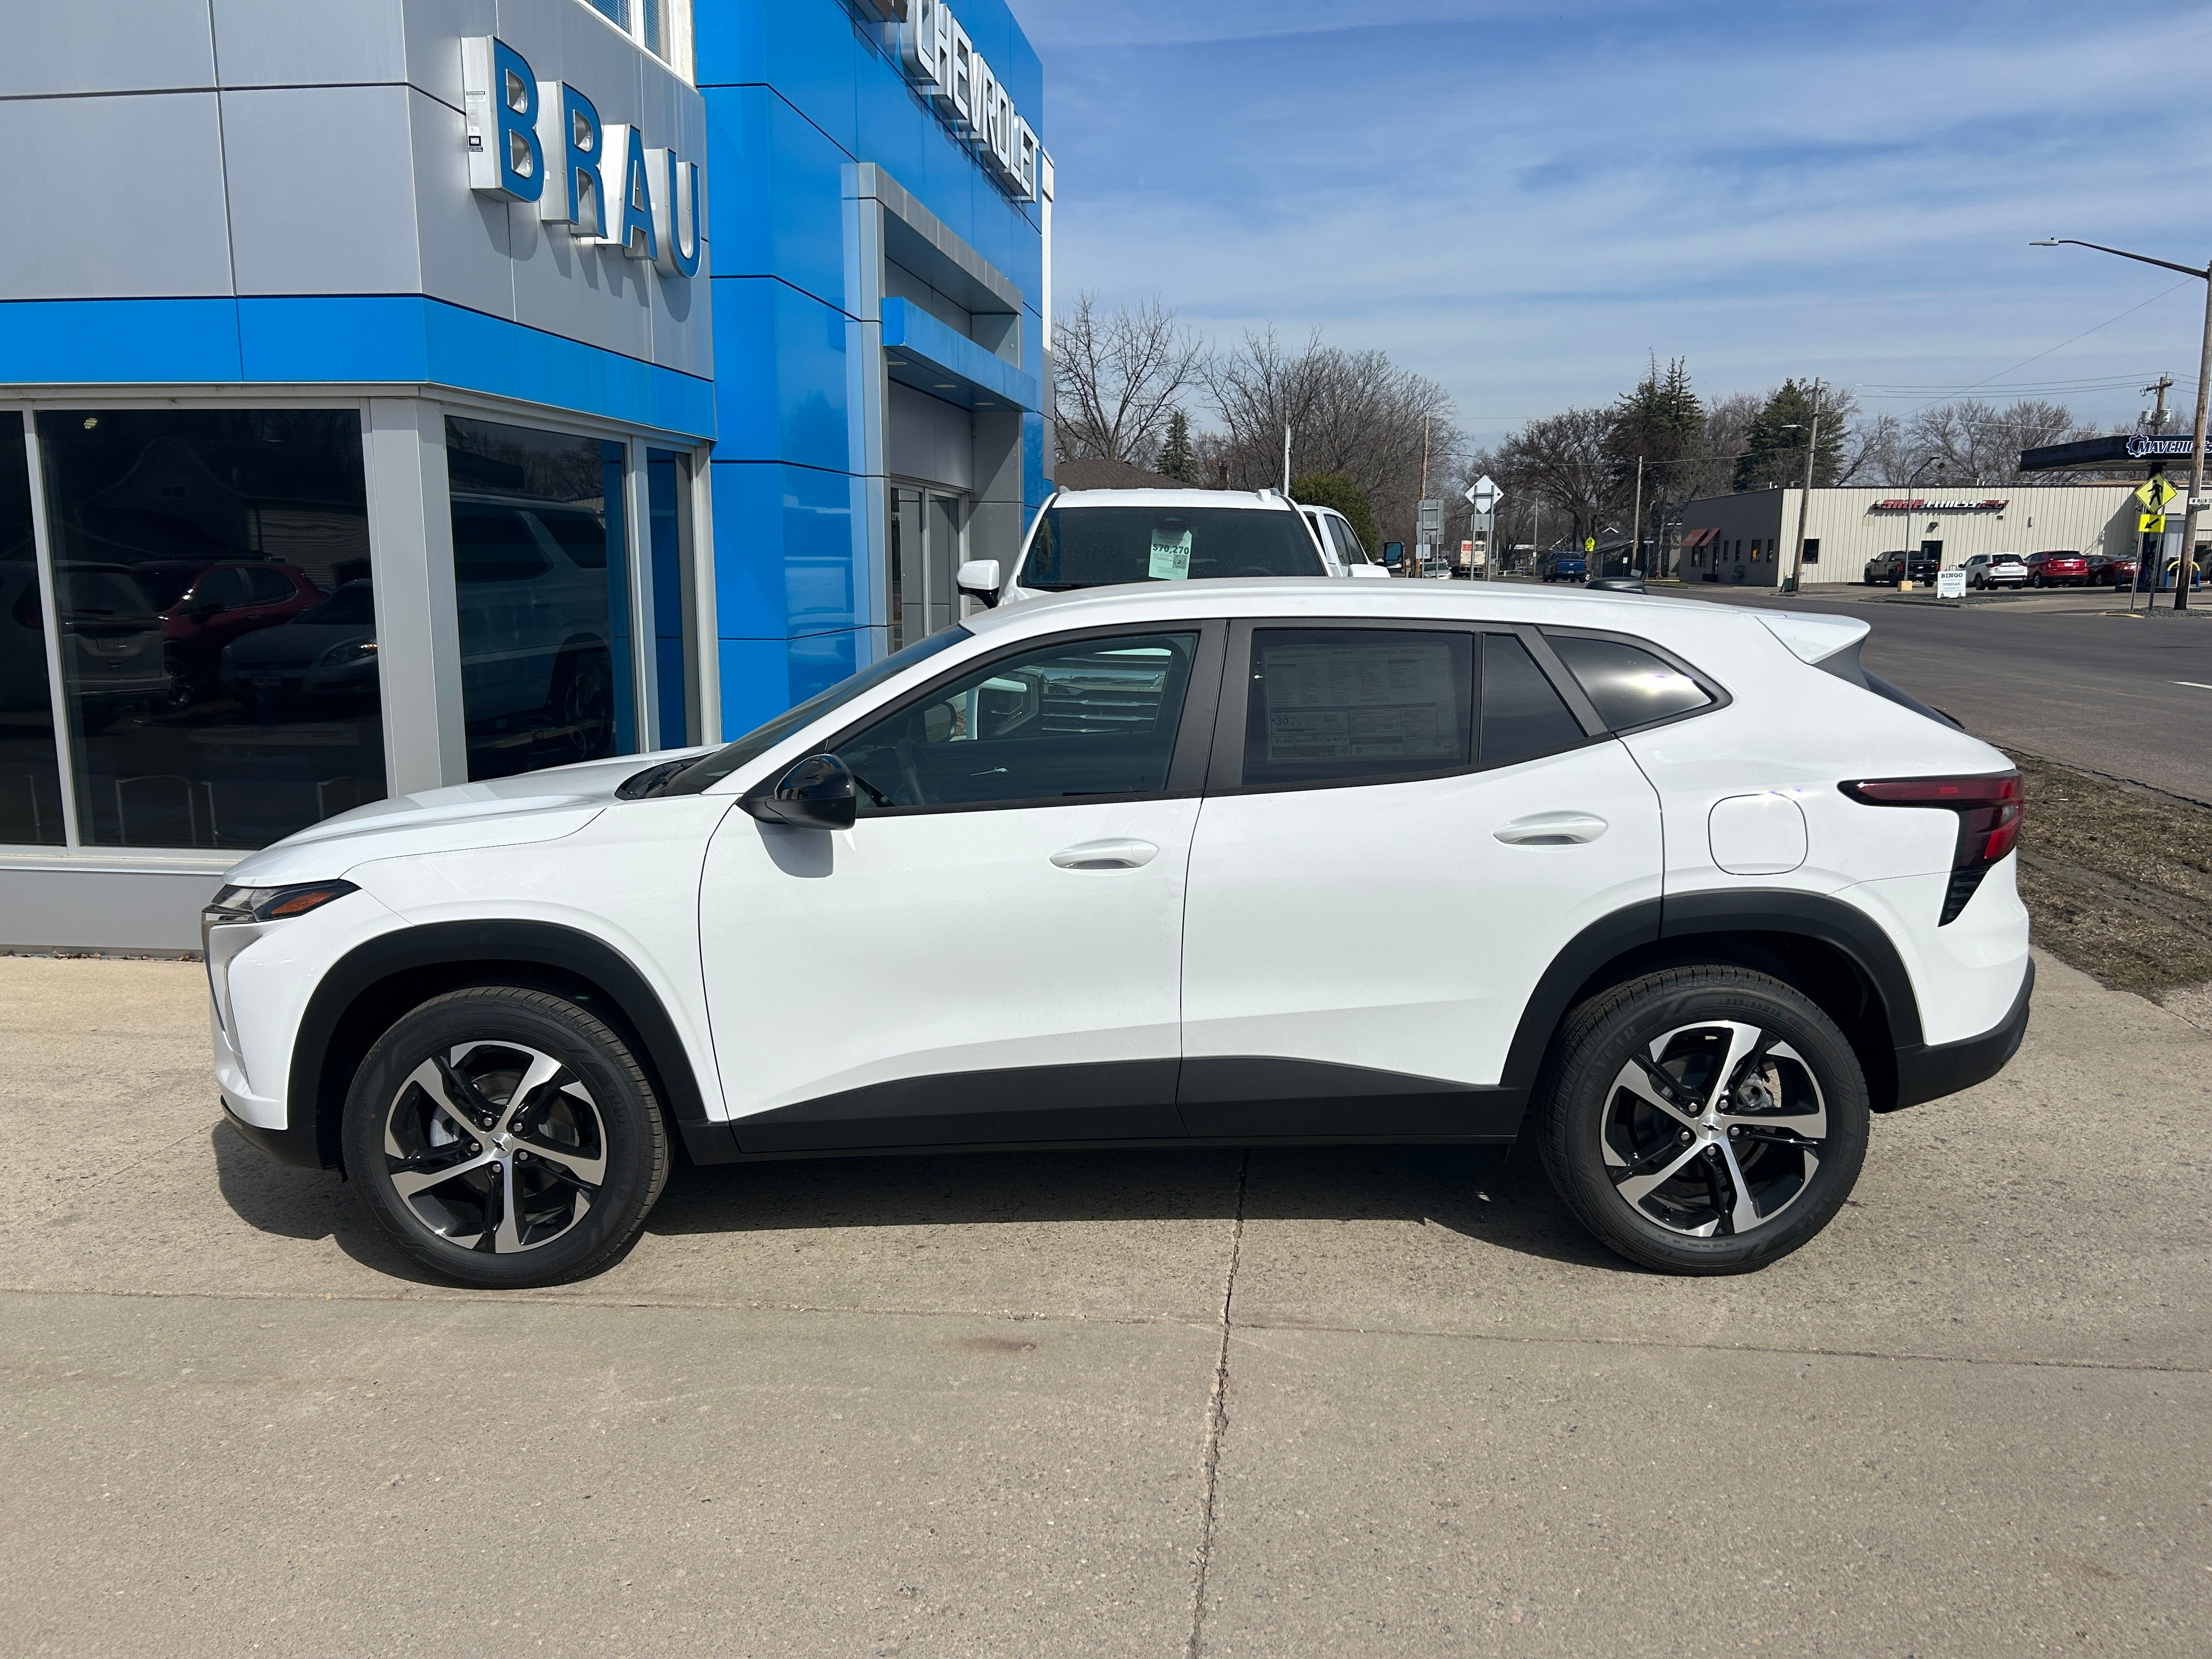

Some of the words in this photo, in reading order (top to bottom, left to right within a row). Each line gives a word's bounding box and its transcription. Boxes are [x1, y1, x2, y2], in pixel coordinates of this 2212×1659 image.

[902, 0, 1040, 203] CHEVROLET
[486, 36, 702, 278] BRAU
[2137, 441, 2212, 454] MAVERIC'S
[1926, 500, 1977, 509] FITNESS
[1153, 544, 1189, 555] $70,270
[1276, 717, 1289, 725] 30
[1575, 1024, 1638, 1135] GOODYEAR
